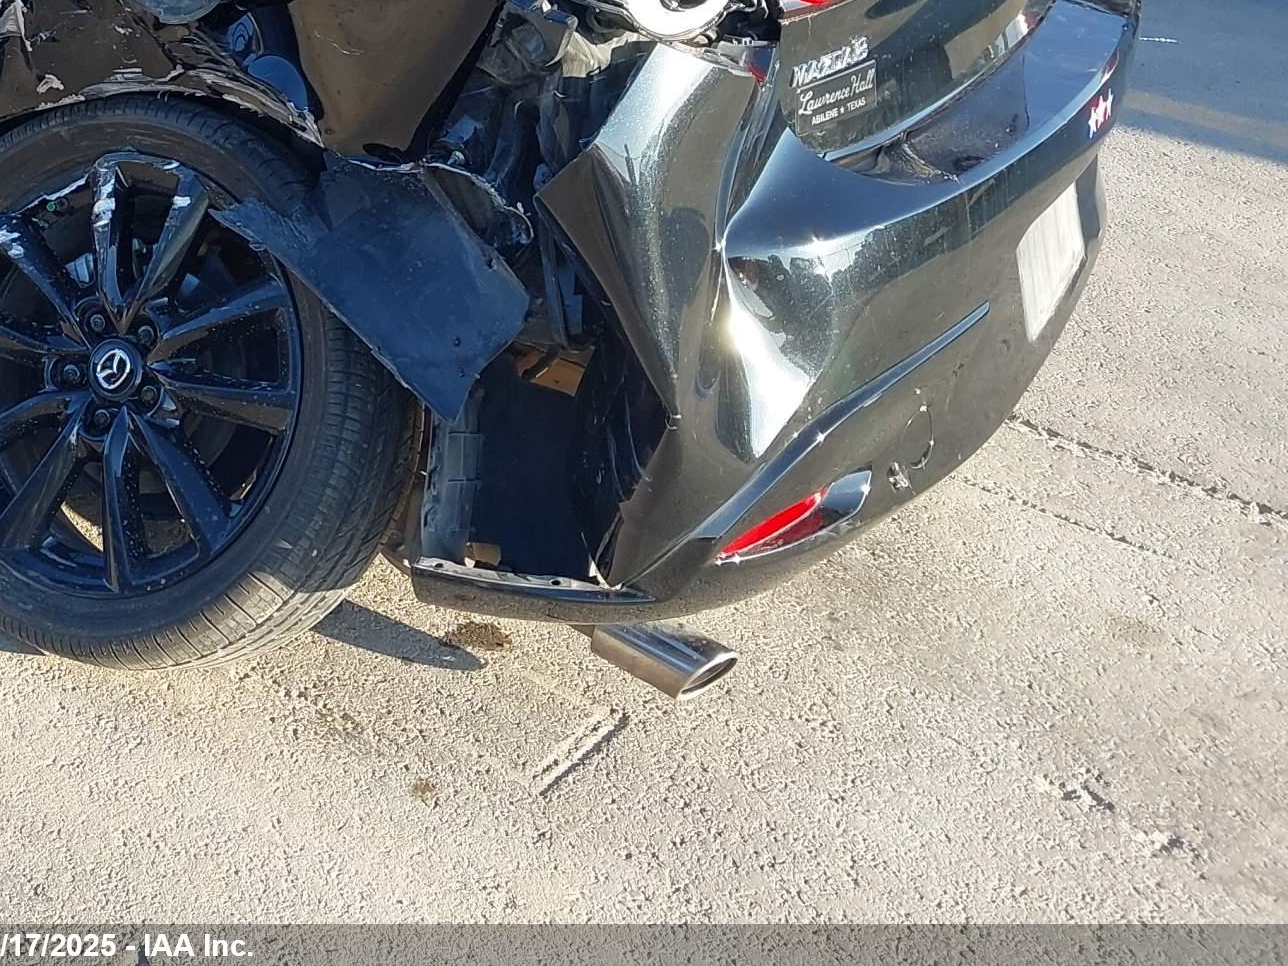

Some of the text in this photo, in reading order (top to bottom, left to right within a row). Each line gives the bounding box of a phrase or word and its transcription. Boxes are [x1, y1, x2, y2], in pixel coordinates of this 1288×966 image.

[798, 68, 876, 115] Lawrence Hall
[811, 97, 866, 126] ABILENE TEXAS
